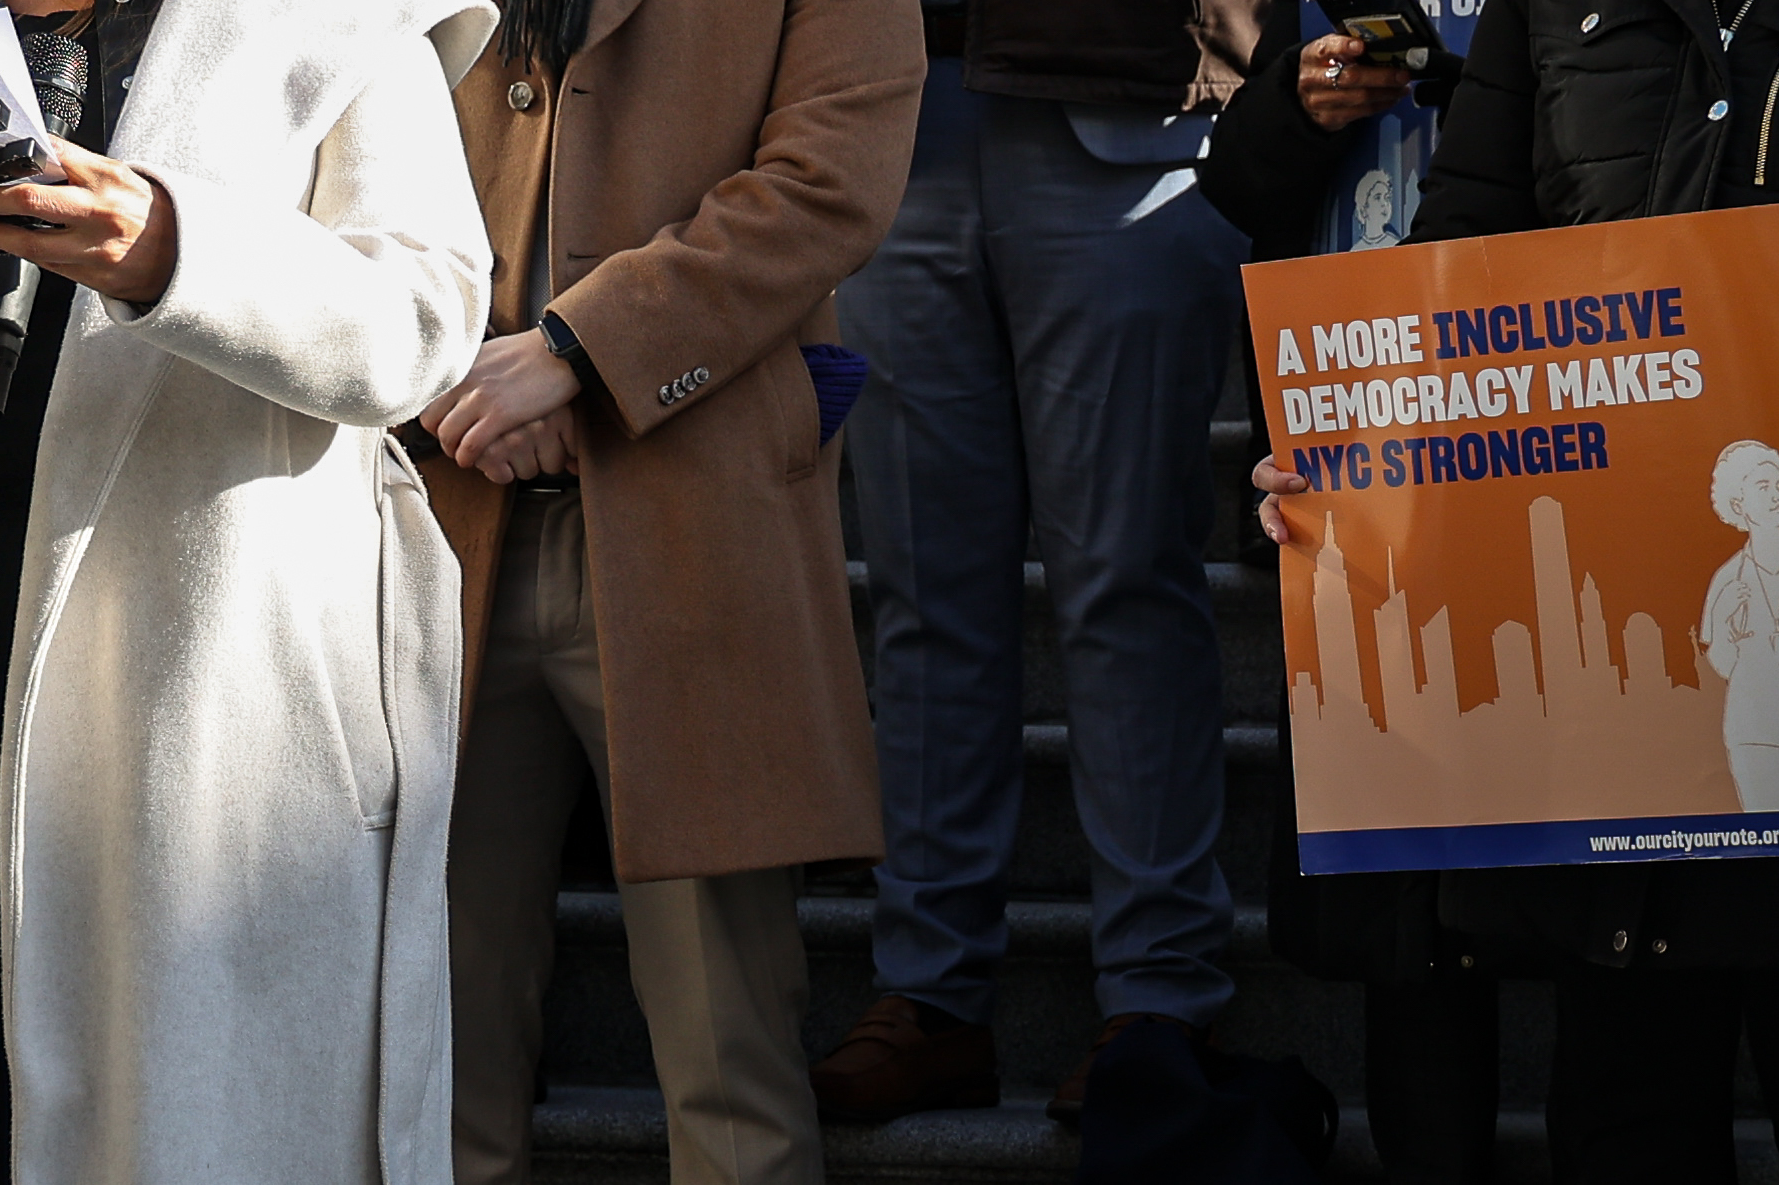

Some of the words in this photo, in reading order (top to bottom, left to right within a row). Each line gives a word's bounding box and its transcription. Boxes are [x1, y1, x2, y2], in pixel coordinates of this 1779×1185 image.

[1277, 328, 1307, 376] A
[1312, 314, 1424, 372] MORE
[1432, 287, 1685, 359] INCLUSIVE
[1282, 365, 1534, 435] DEMOCRACY
[1547, 348, 1703, 411] MAKES
[1292, 442, 1372, 493] NYC
[1381, 421, 1609, 487] STRONGER
[1590, 828, 1779, 852] www.ourcityourvote.or
